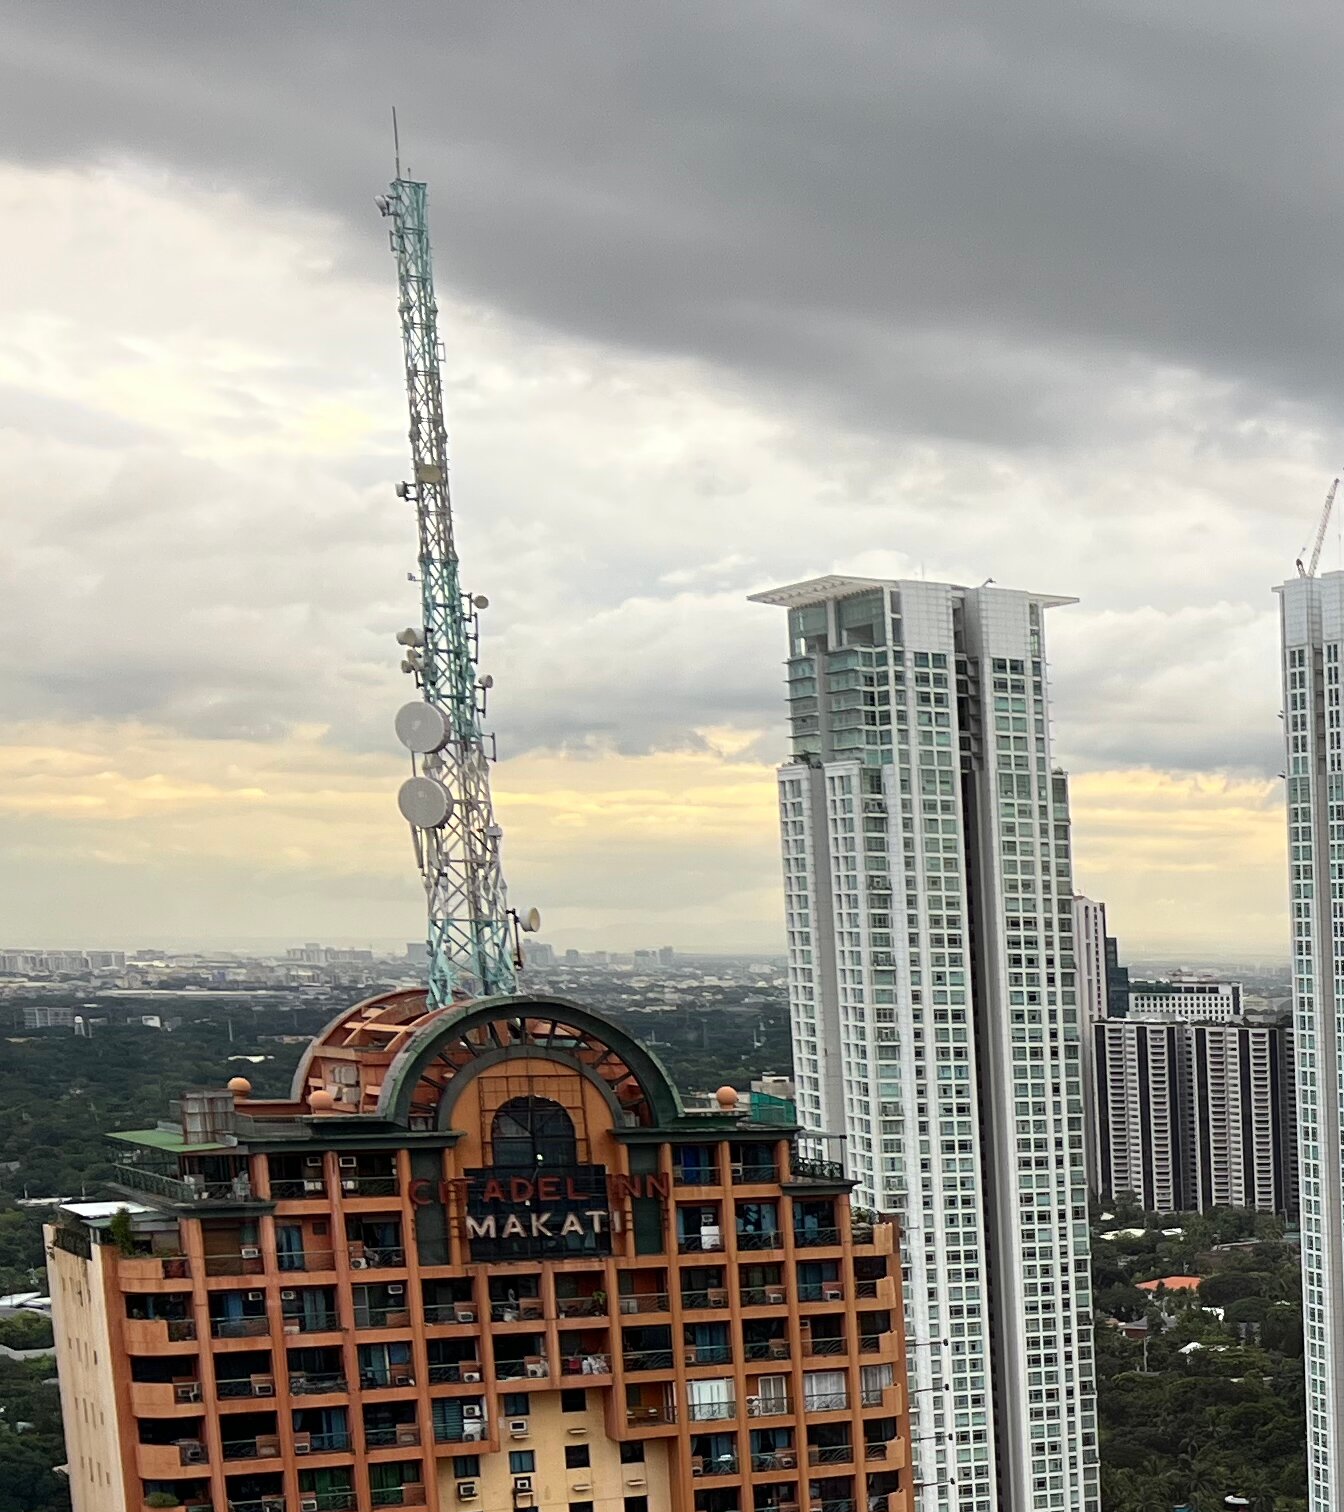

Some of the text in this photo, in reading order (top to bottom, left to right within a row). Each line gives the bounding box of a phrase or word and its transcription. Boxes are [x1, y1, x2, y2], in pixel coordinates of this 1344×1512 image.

[409, 1172, 670, 1205] CITADEL INN
[465, 1209, 622, 1240] MAKATI
